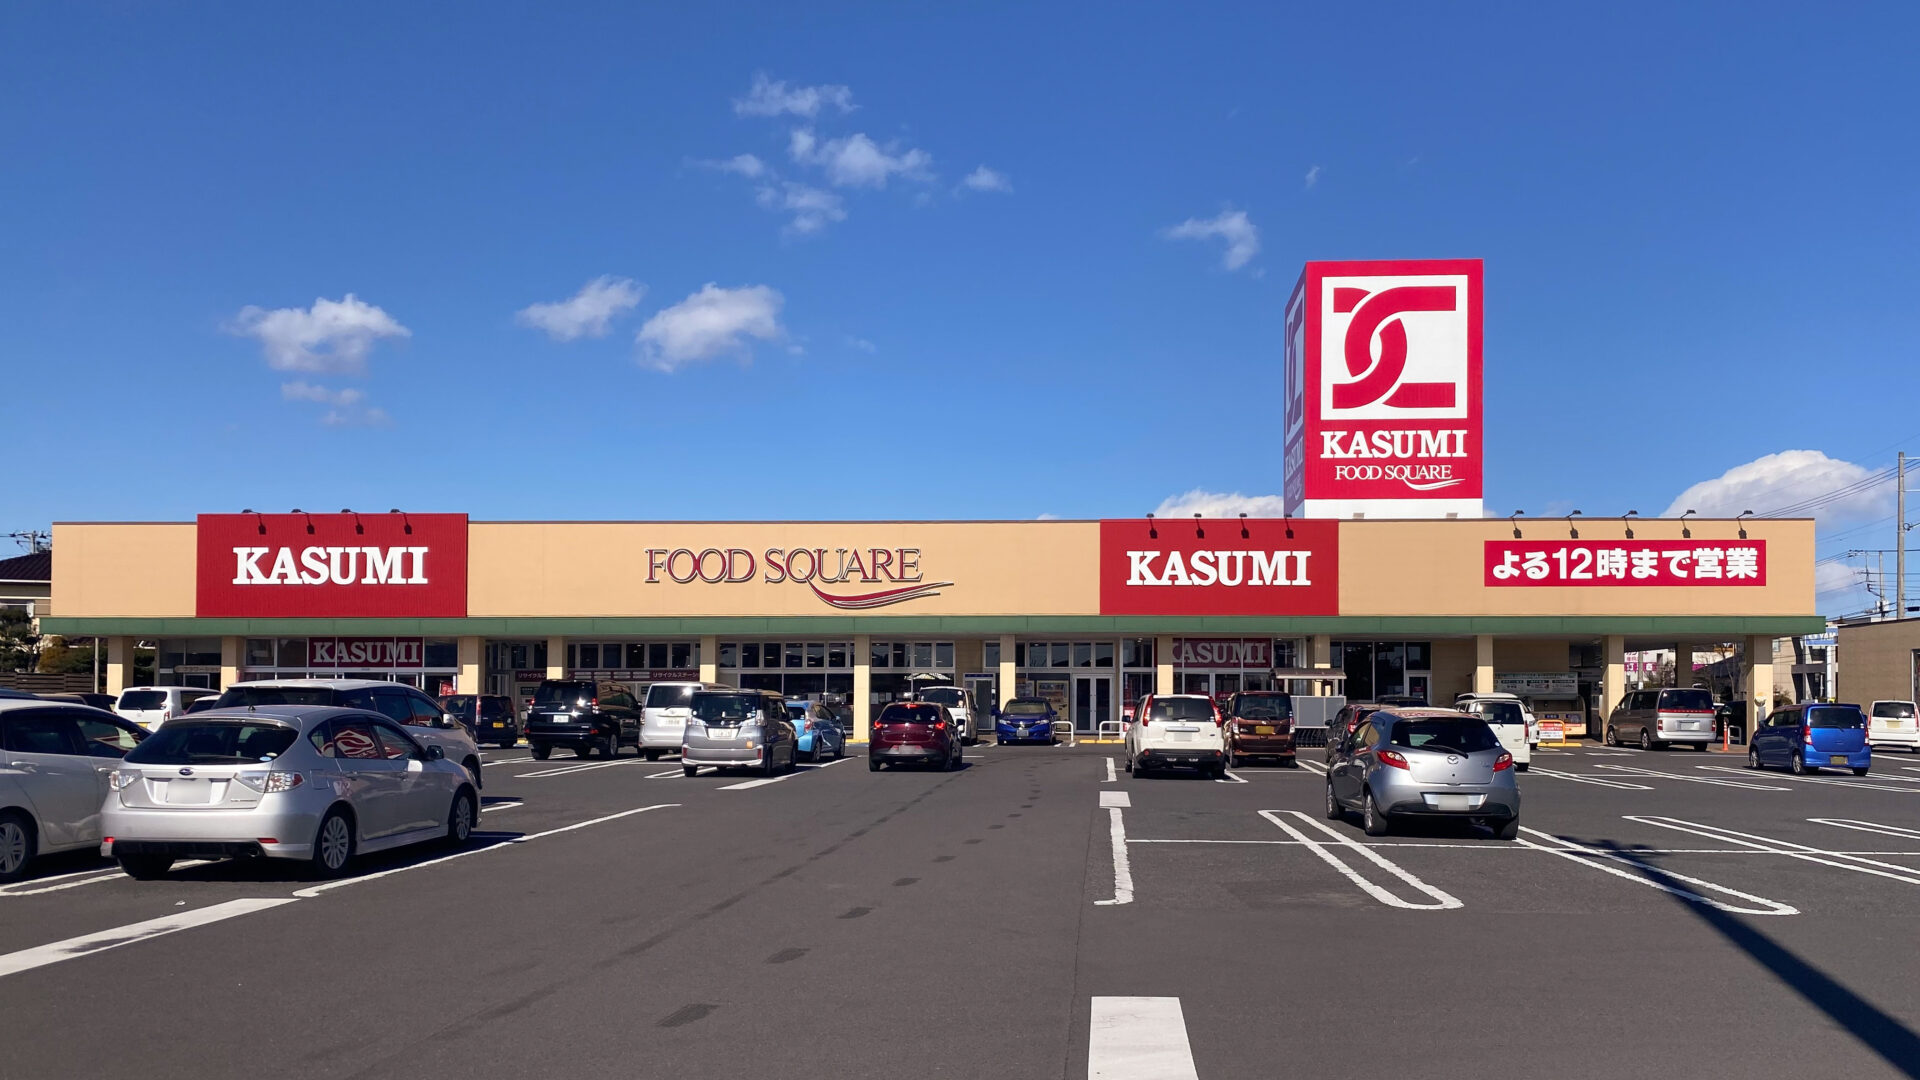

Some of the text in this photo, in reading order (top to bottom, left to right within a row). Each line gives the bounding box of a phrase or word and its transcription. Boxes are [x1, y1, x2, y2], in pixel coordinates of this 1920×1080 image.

[1320, 430, 1468, 459] KASUMI
[1335, 465, 1382, 480] FOOD
[232, 546, 429, 585] KASUMI
[645, 548, 924, 583] FOOD SQUARE
[1126, 550, 1312, 587] KASUMI
[1492, 547, 1759, 580] よる12時まで営業
[313, 641, 420, 663] KASUMI
